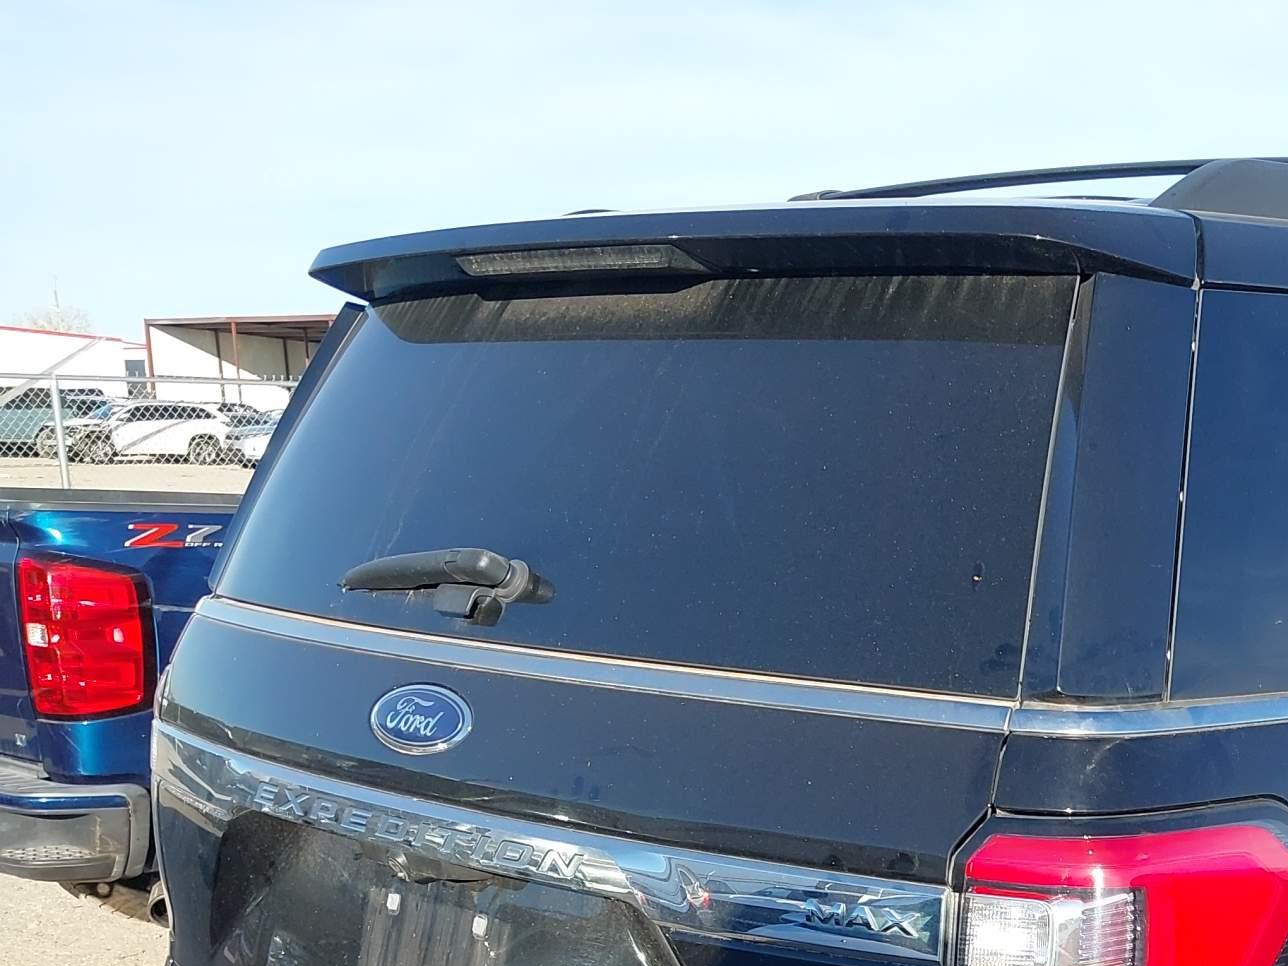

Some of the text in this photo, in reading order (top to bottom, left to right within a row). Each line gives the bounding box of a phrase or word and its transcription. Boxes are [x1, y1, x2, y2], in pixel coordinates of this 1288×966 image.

[386, 696, 444, 736] Ford
[253, 779, 584, 878] EXPEDITION
[804, 898, 921, 938] MAX
